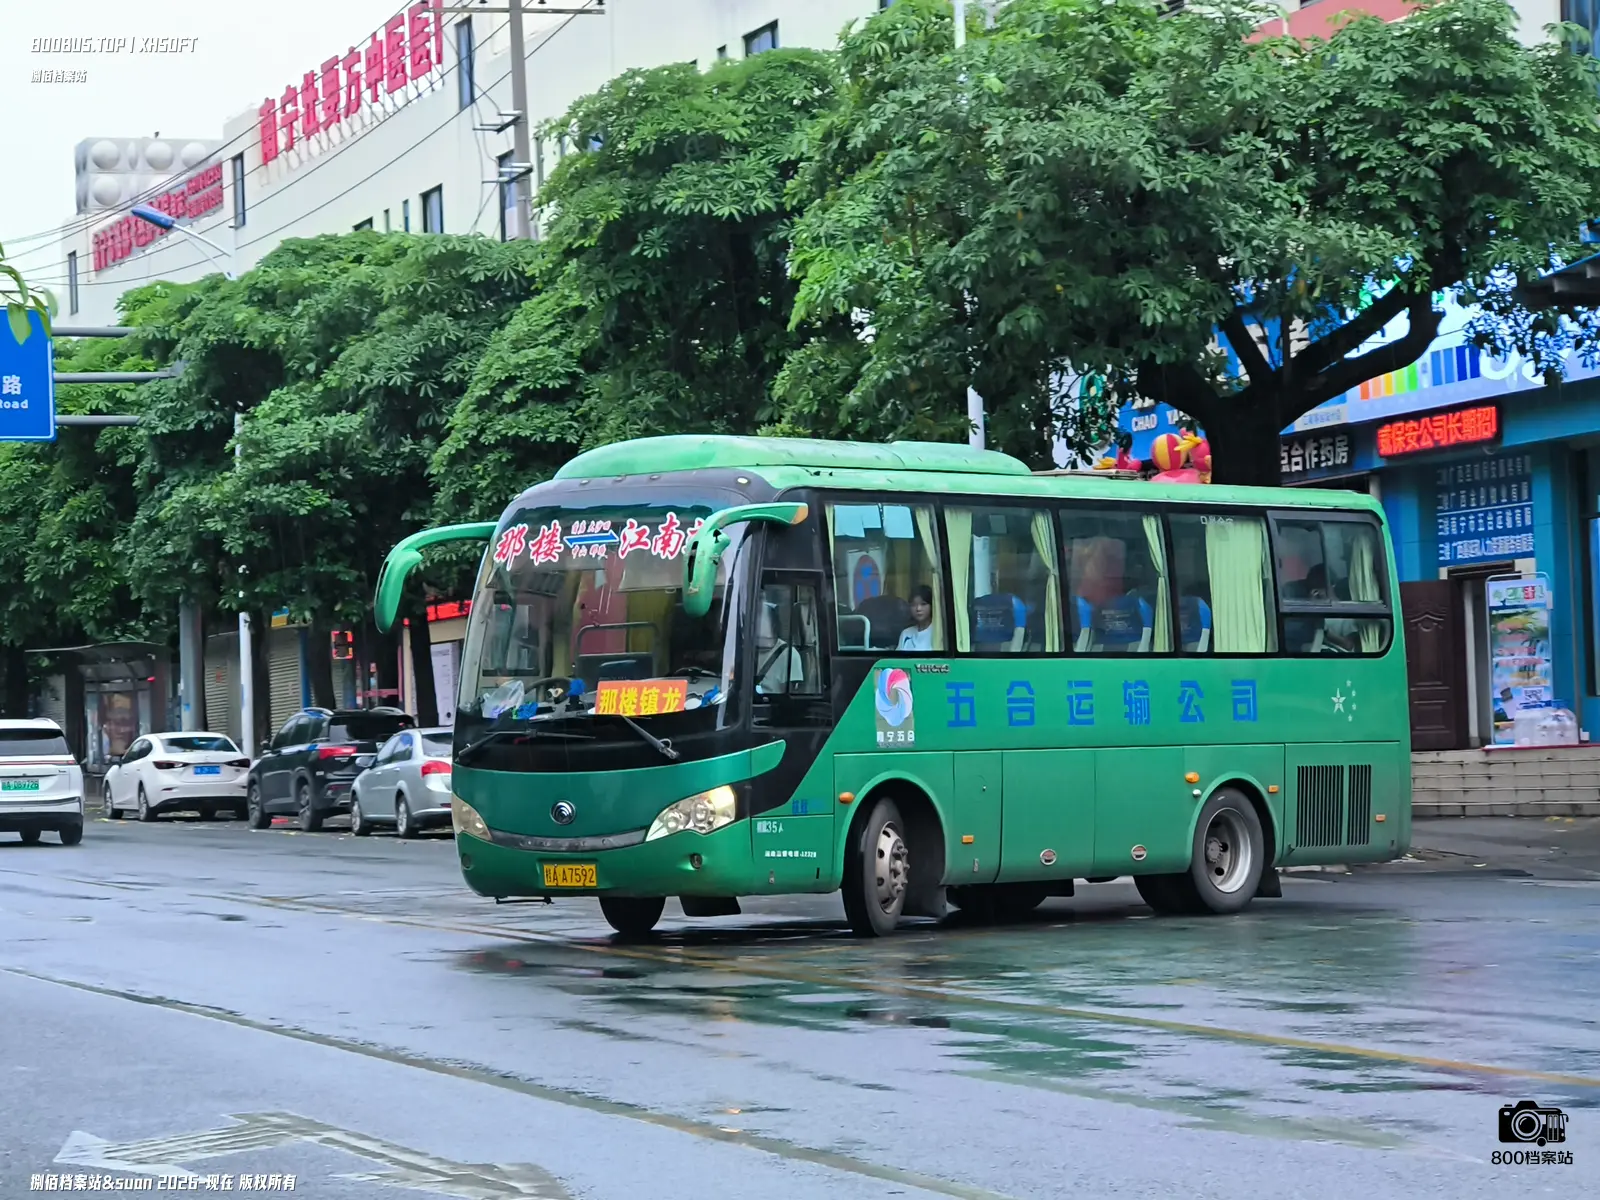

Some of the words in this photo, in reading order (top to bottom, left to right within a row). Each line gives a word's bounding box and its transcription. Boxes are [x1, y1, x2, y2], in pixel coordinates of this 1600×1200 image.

[2, 375, 22, 395] 路
[1131, 413, 1158, 432] CHAO
[494, 522, 565, 572] 那楼
[599, 686, 682, 717] 那楼镇龙
[945, 679, 1259, 730] 五合运输公司
[876, 730, 915, 743] 南宁五合
